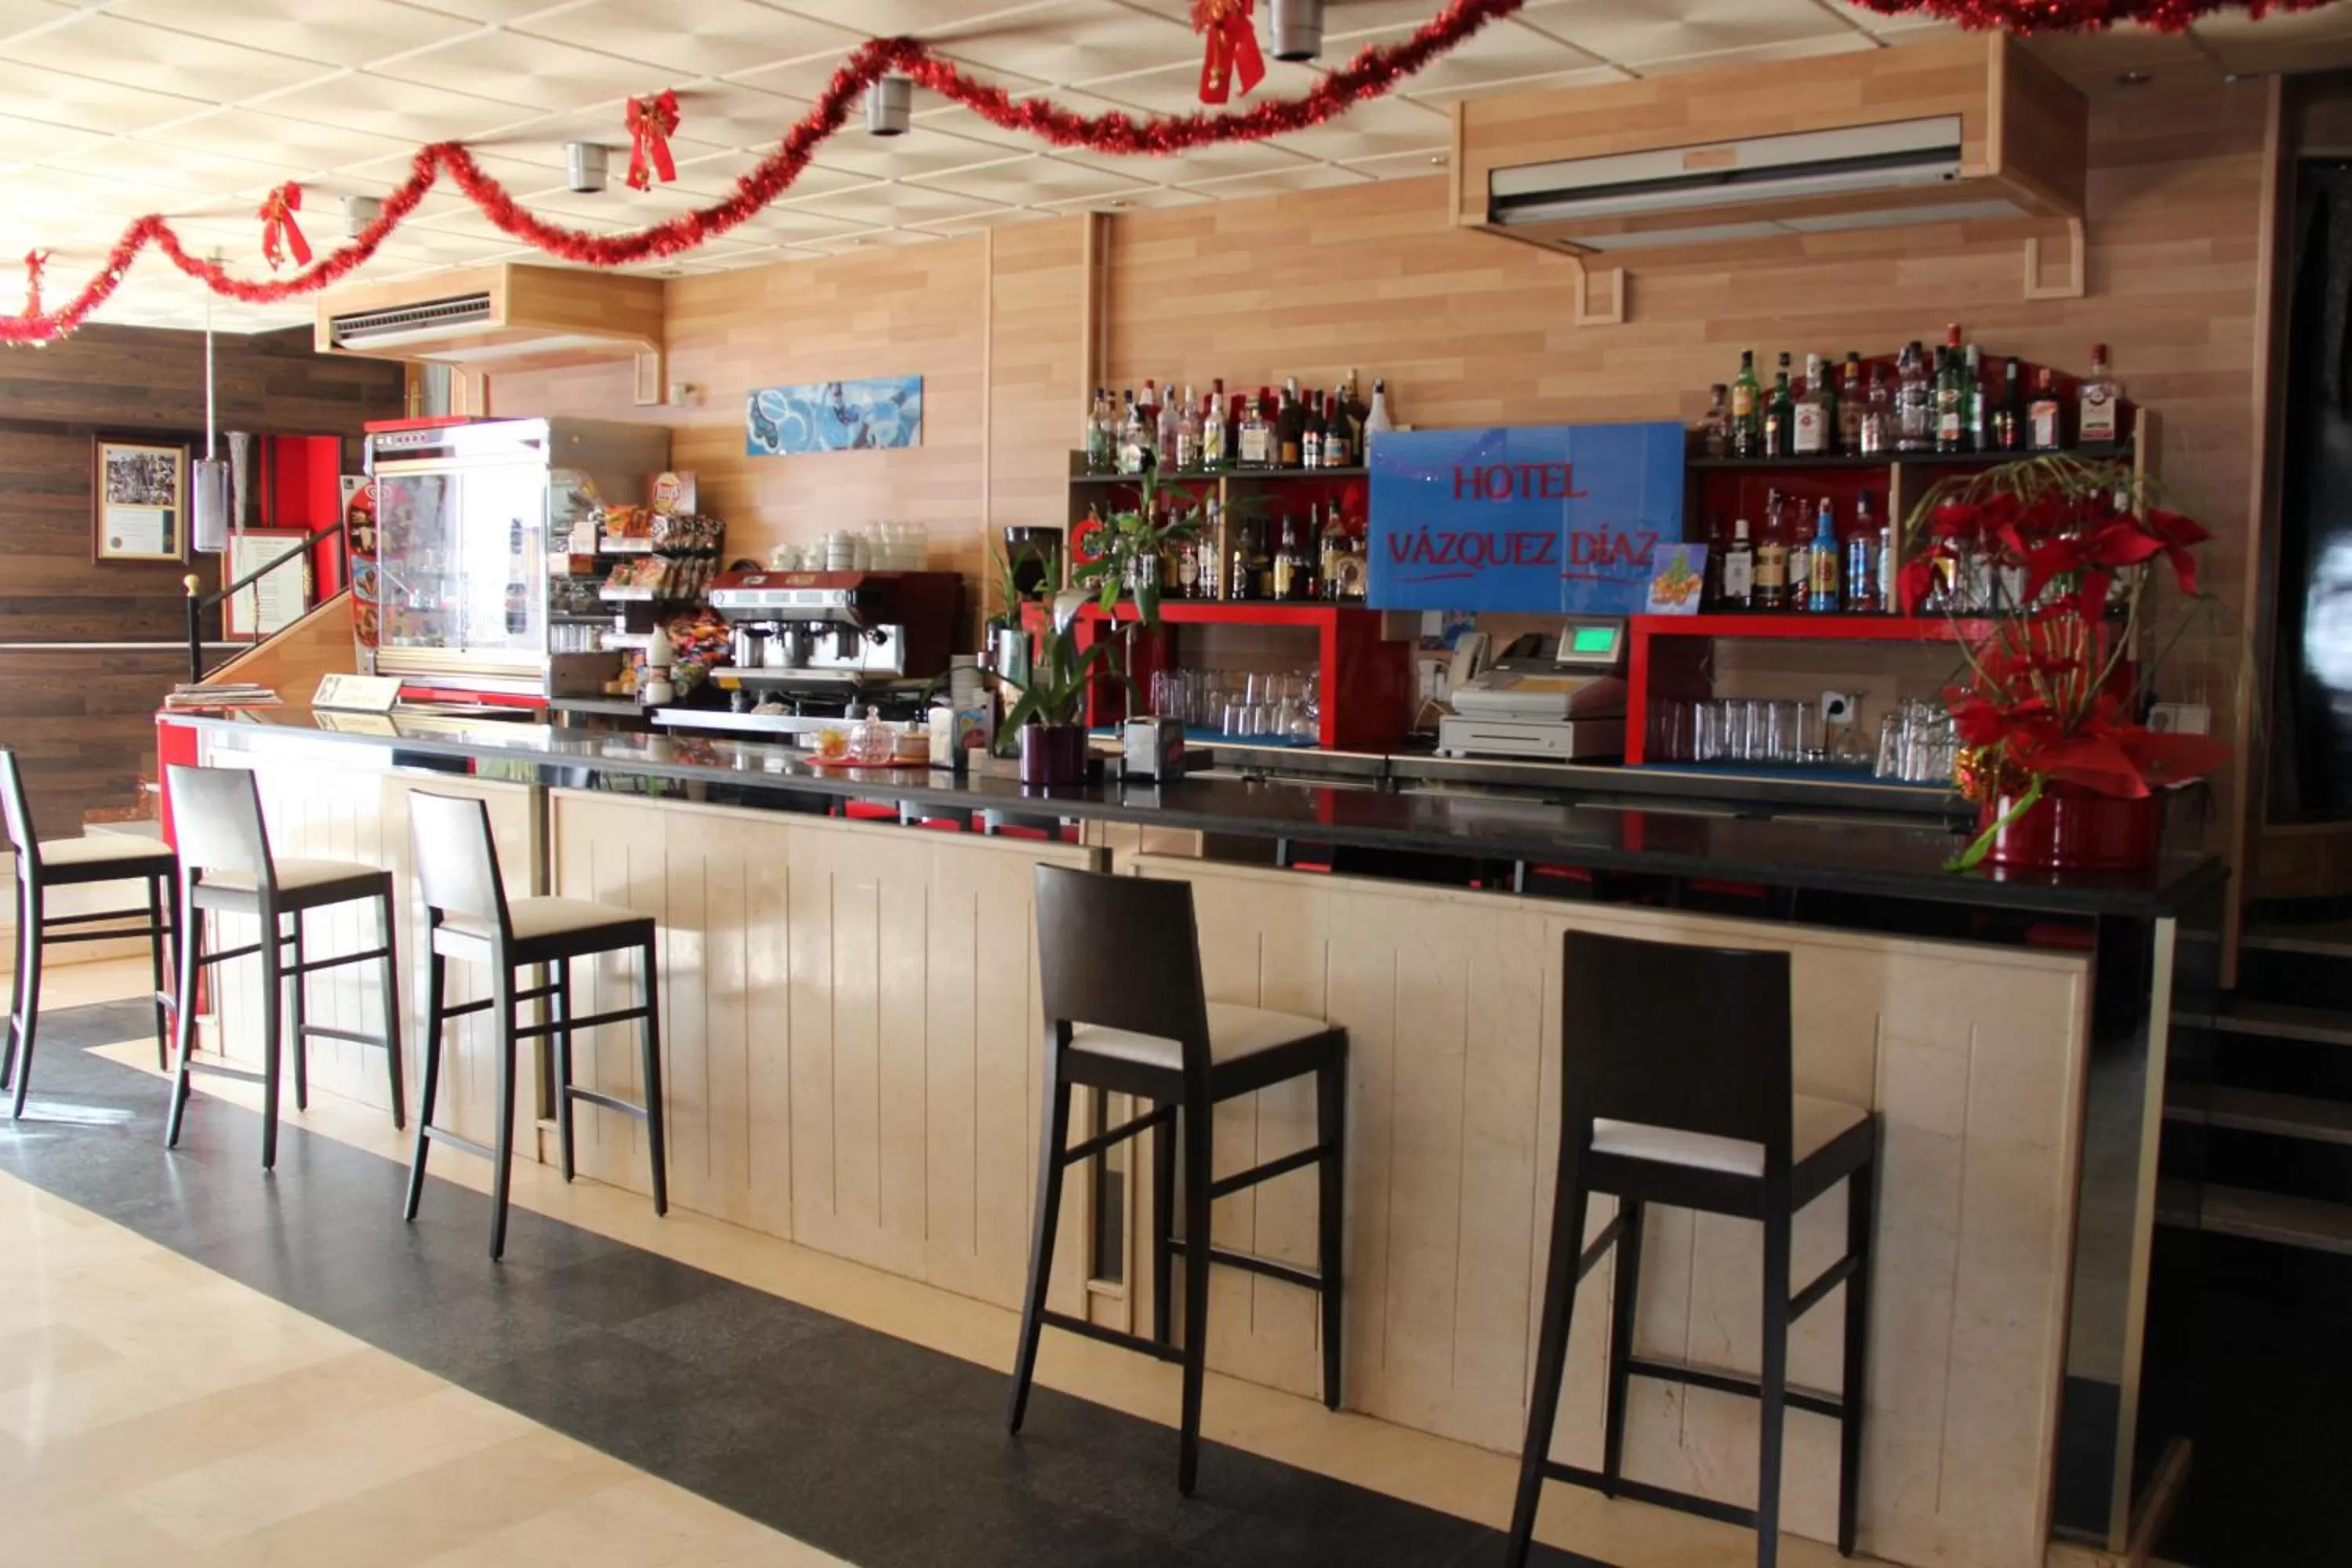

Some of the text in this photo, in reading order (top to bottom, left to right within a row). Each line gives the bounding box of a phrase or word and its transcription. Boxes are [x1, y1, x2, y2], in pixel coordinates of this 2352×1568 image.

[1454, 463, 1588, 500] HOTEL
[1387, 523, 1658, 570] VÁZQUEZ DÍAZ
